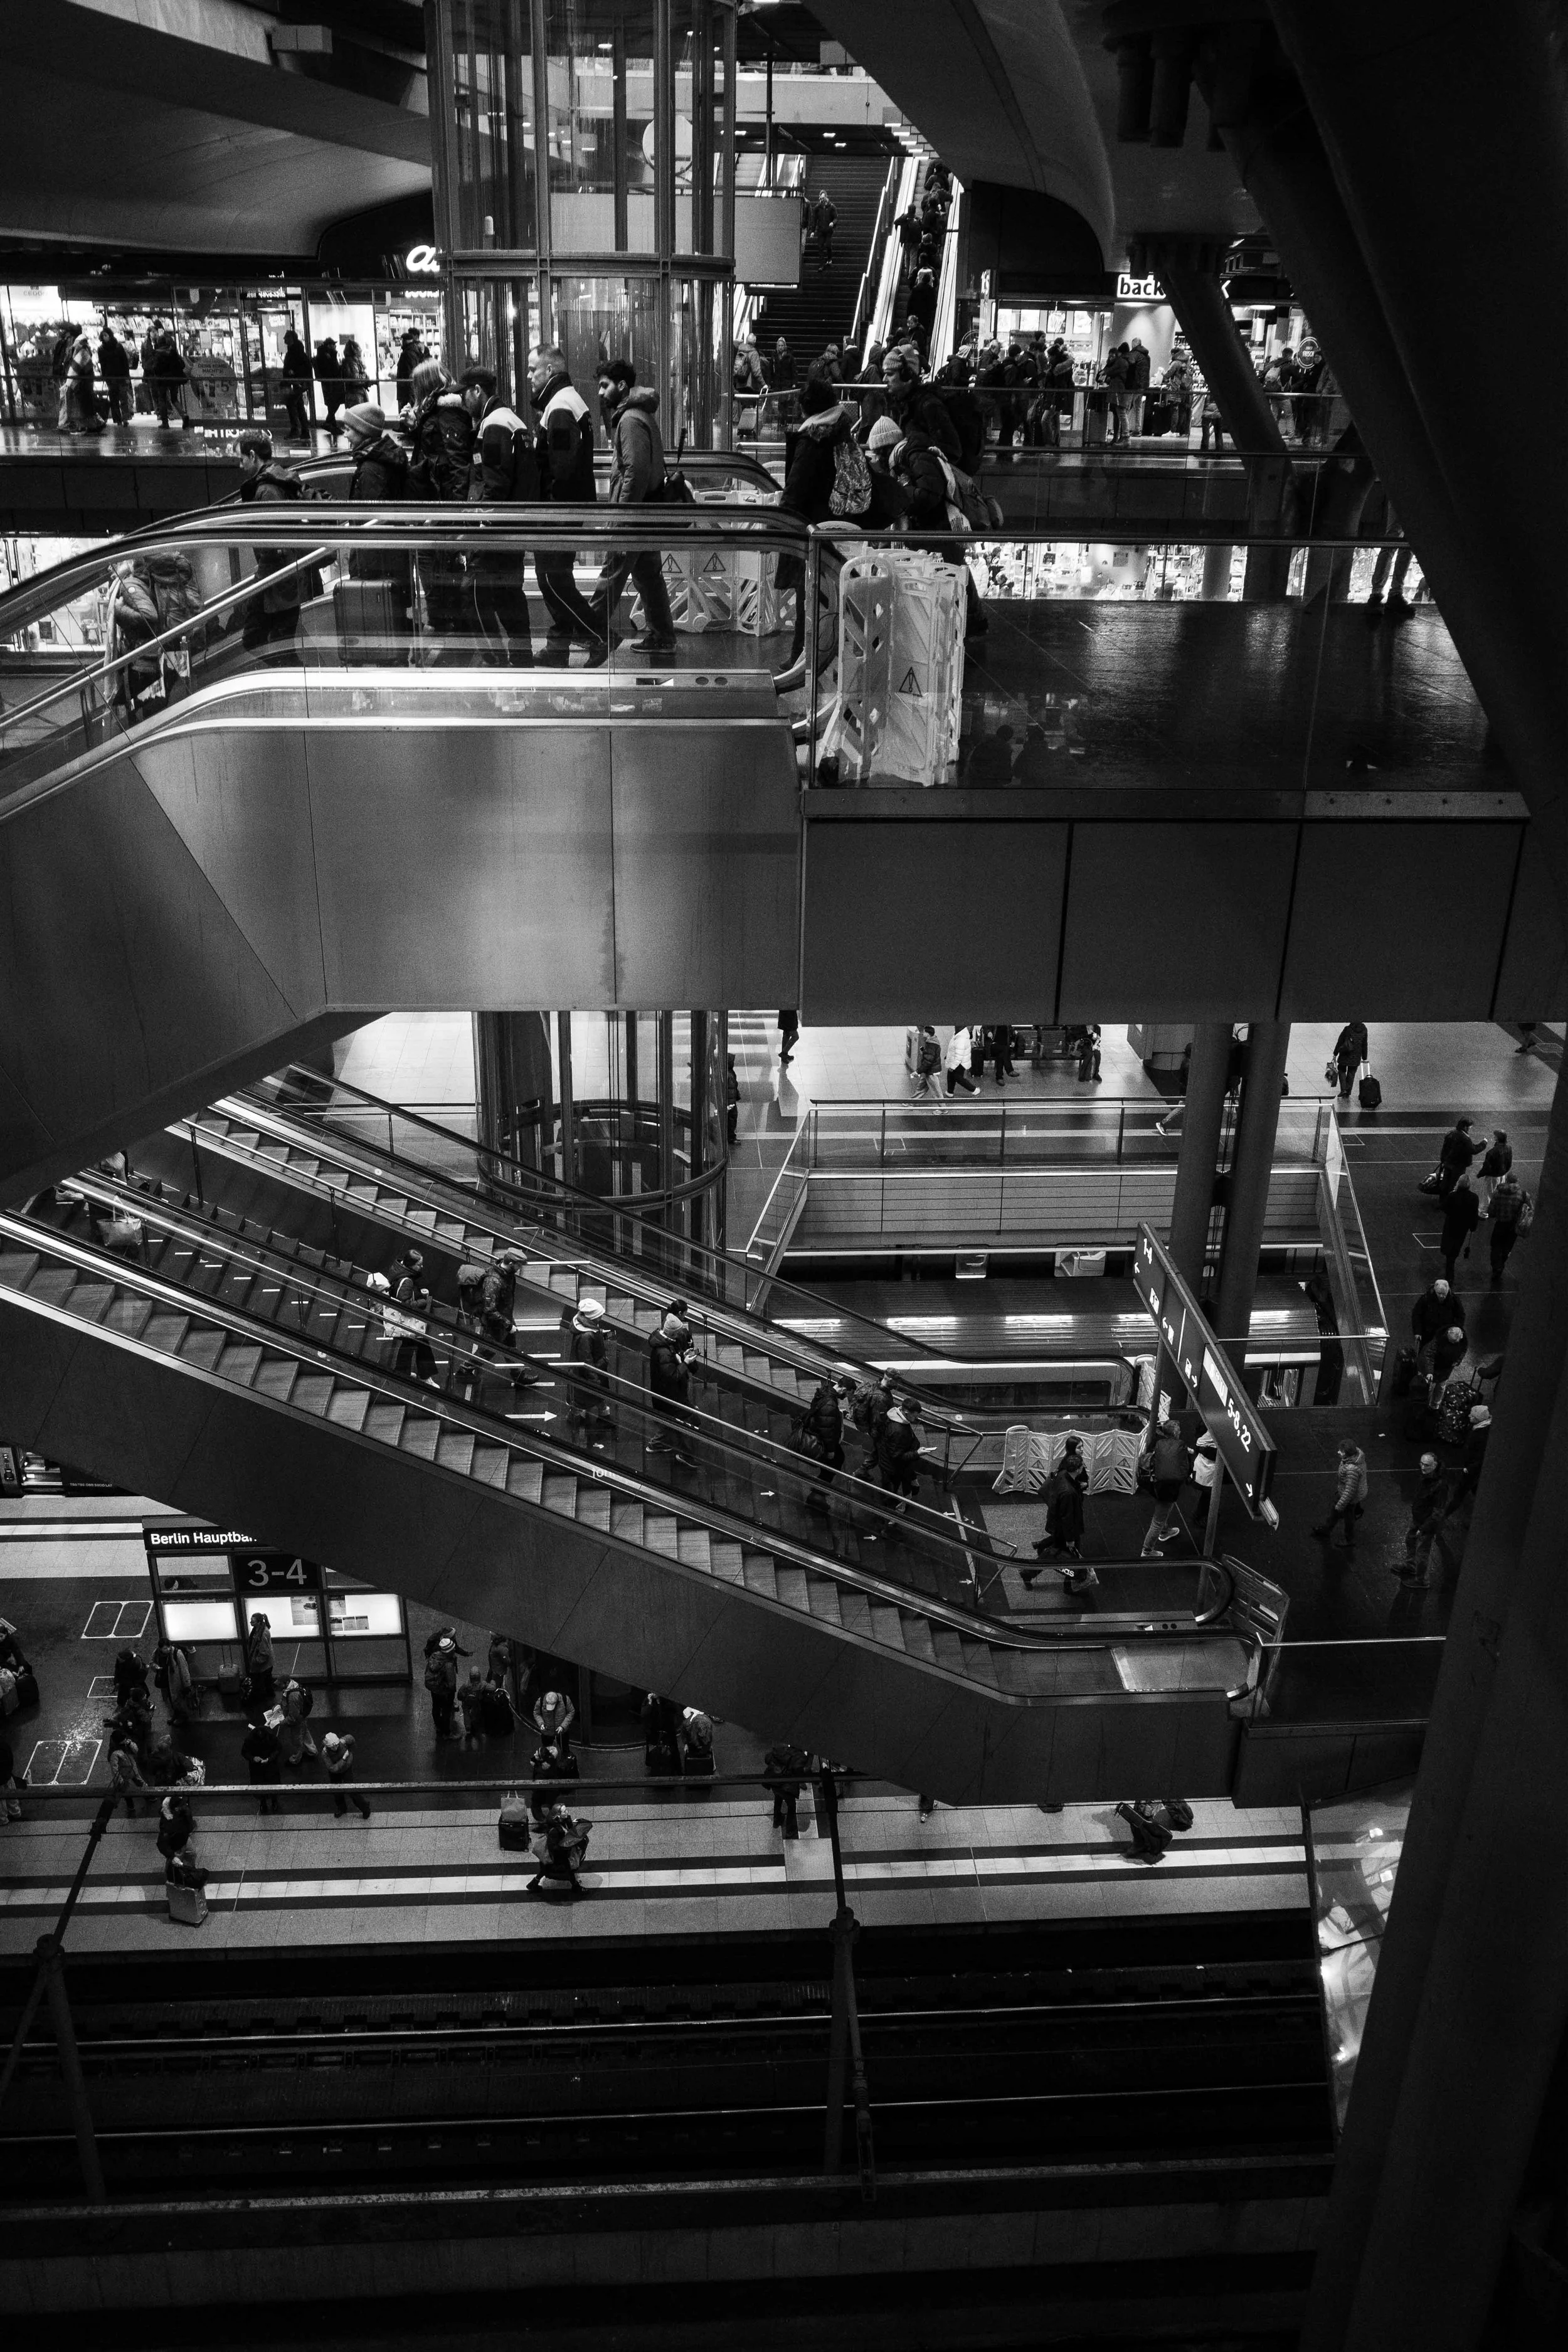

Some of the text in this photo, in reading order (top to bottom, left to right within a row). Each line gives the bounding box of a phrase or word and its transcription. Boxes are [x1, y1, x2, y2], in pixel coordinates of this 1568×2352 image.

[1143, 1238, 1152, 1264] 1-4
[151, 1532, 257, 1545] Berlin Hauptba
[247, 1559, 307, 1587] 3-4
